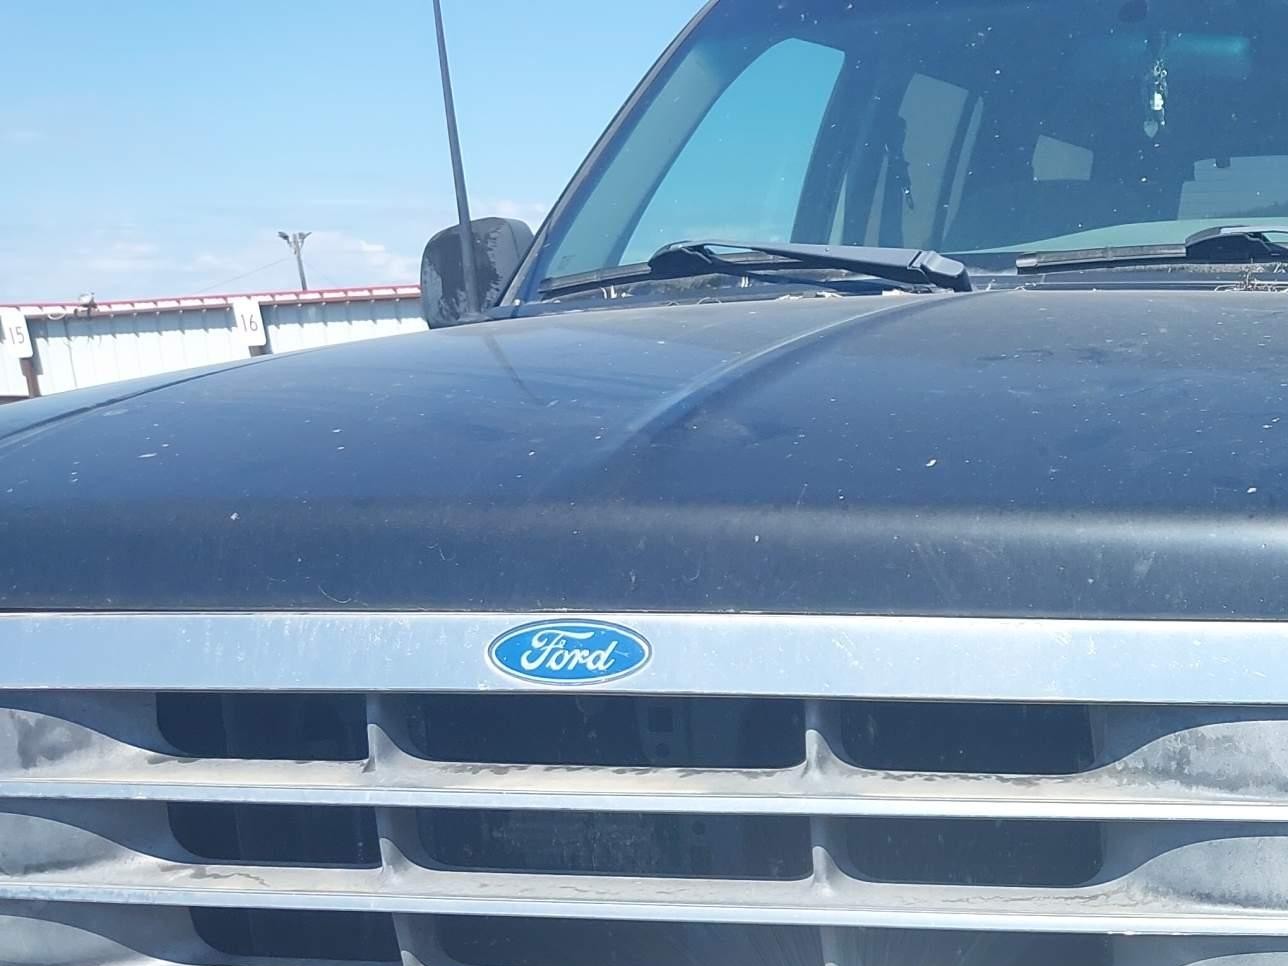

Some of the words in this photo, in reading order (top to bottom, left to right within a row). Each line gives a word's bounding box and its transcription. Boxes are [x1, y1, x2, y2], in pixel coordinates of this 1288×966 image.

[241, 314, 259, 333] 16
[9, 327, 25, 345] 15
[520, 629, 618, 671] Ford
